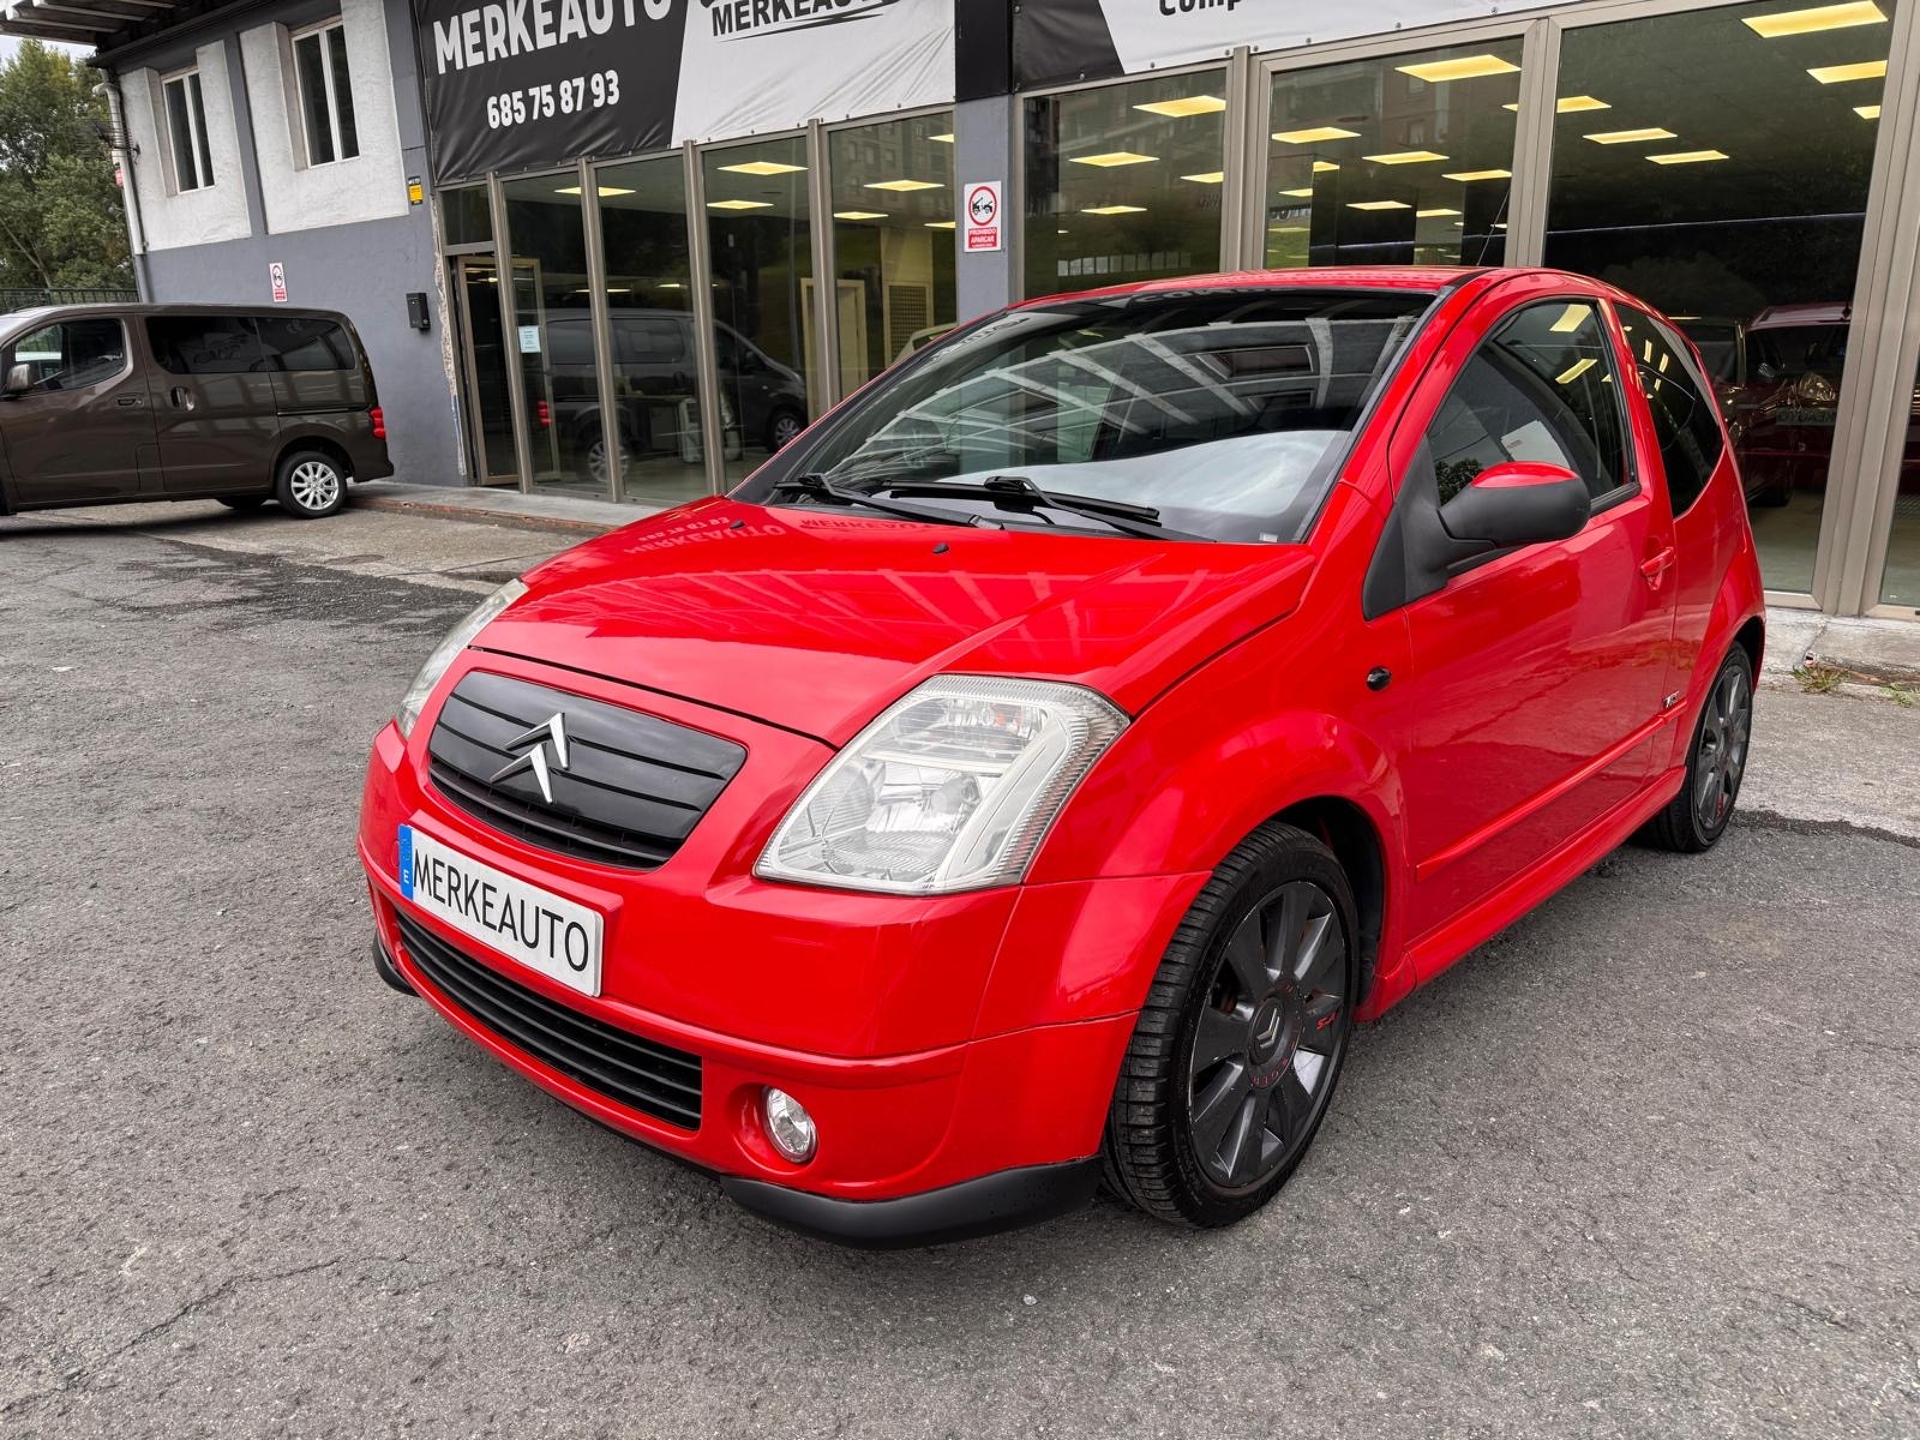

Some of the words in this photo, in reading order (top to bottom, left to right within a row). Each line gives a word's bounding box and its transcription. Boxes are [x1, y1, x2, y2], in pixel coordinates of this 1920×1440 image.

[712, 0, 890, 37] MERKE
[487, 90, 527, 129] 685
[528, 84, 555, 120] 75
[559, 76, 585, 114] 87
[590, 69, 620, 108] 93
[413, 848, 589, 972] MERKEAUTO
